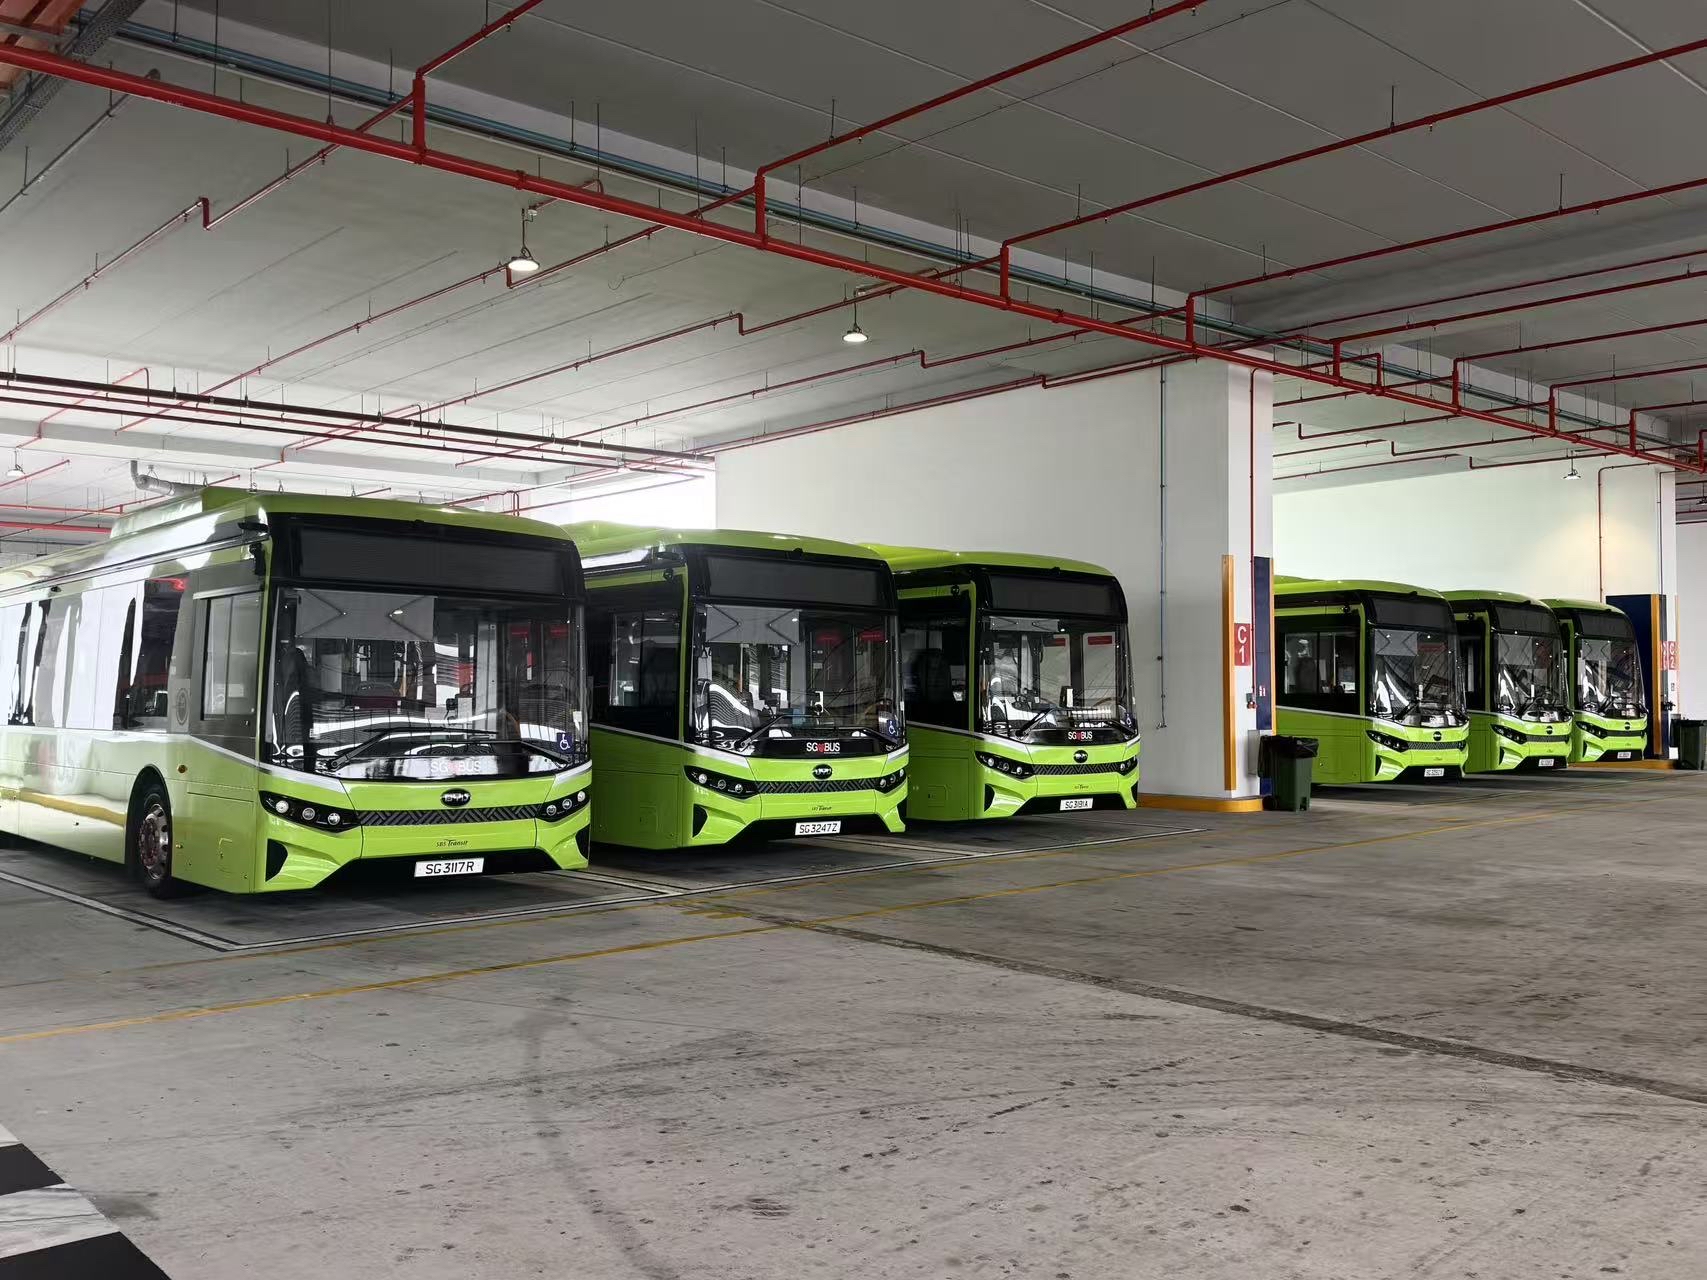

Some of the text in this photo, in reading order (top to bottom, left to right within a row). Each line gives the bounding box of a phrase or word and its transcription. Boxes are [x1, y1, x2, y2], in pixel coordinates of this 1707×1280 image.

[824, 742, 841, 752] BUS
[799, 822, 838, 834] SG3247Z
[425, 861, 475, 875] SG3117R
